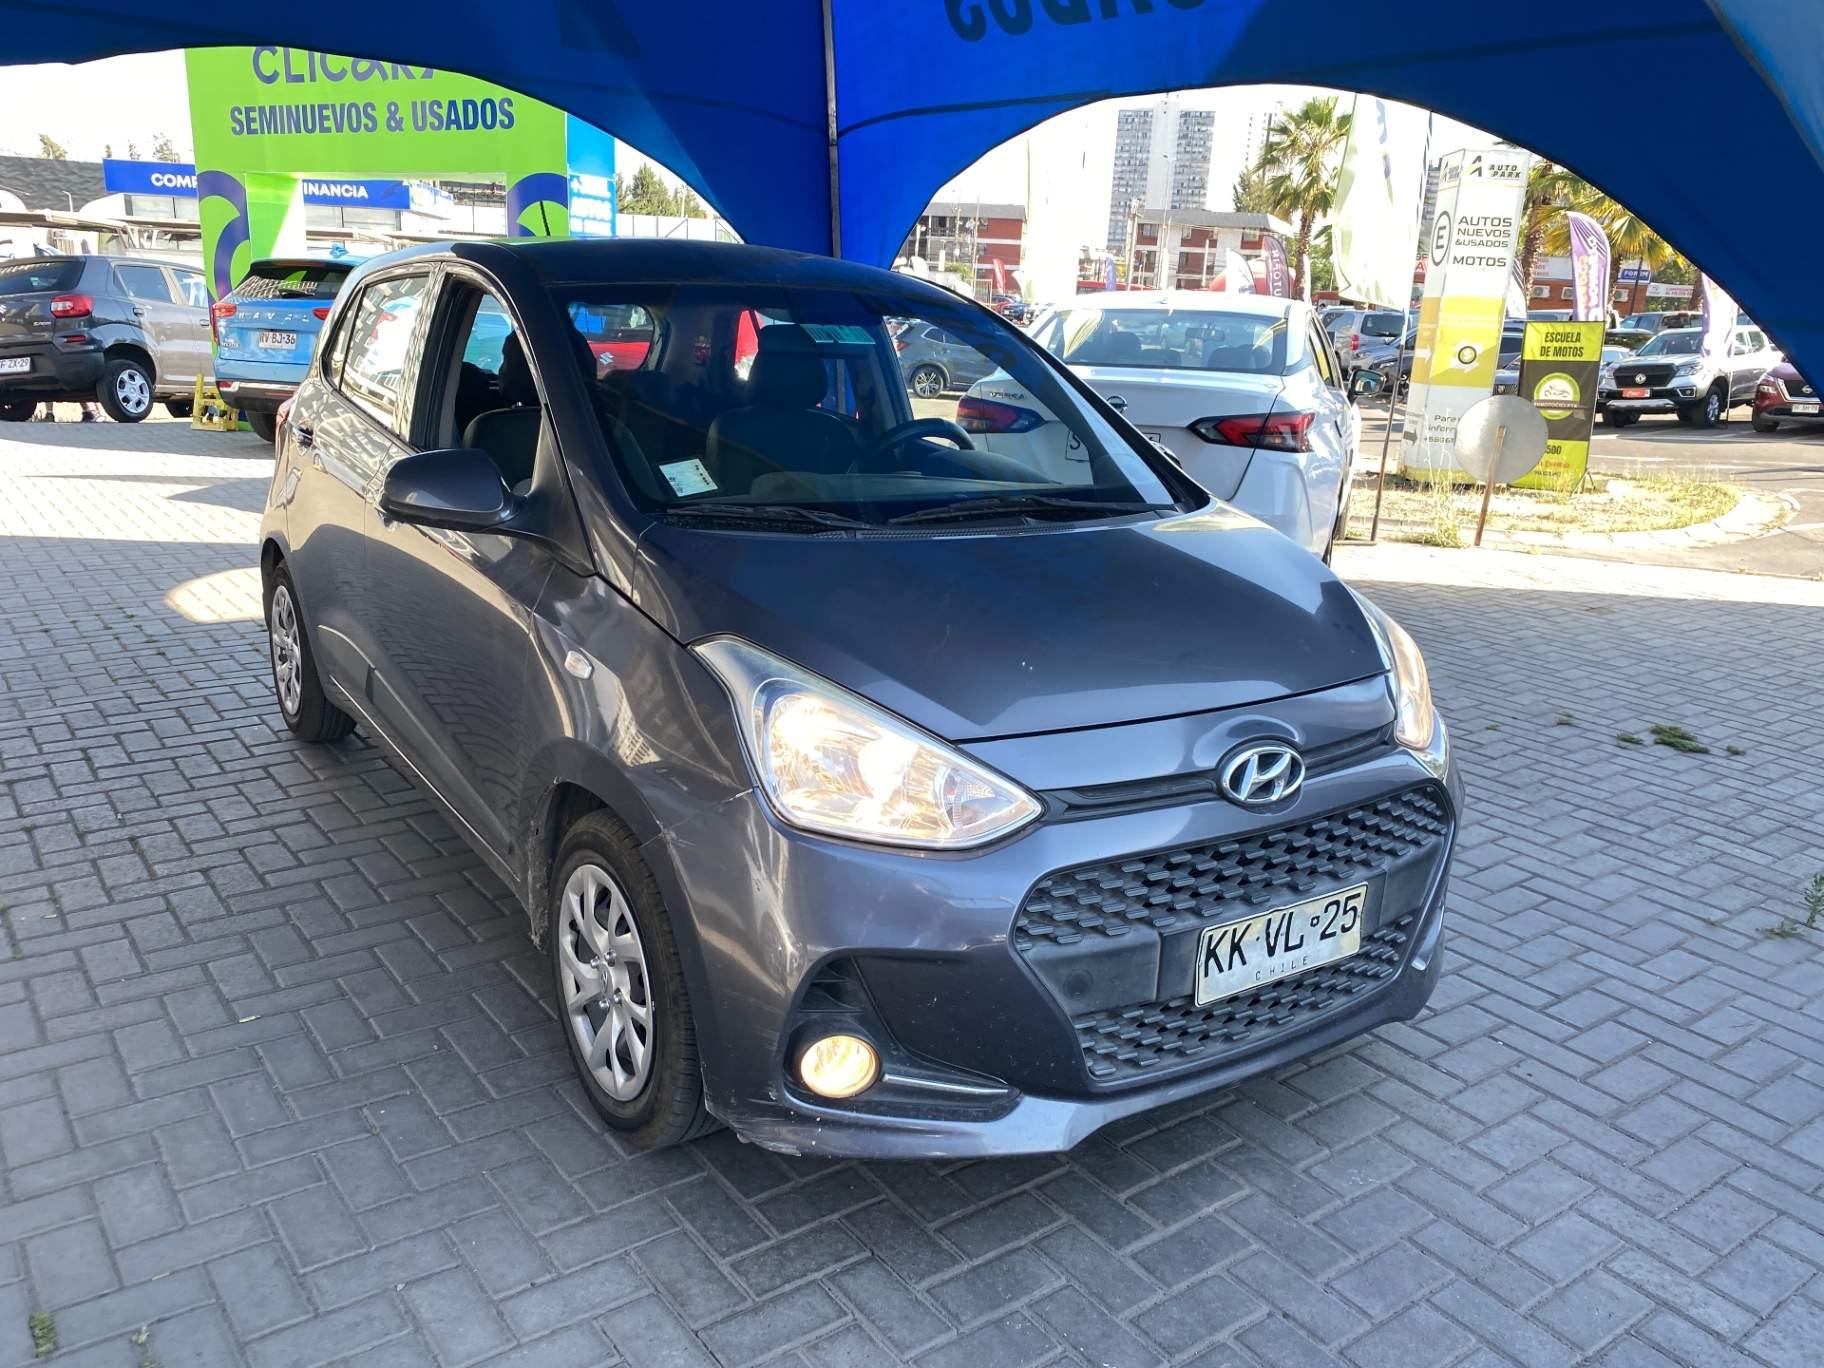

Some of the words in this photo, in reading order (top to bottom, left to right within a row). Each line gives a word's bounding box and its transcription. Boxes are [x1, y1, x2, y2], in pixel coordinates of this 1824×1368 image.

[229, 101, 378, 136] SEMINUEVOS
[385, 100, 405, 133] &
[411, 97, 515, 132] USADOS
[1458, 215, 1513, 228] AUTOS
[1456, 227, 1511, 238] NUEVOS
[1454, 238, 1509, 248] &USADOS
[1452, 255, 1507, 267] MOTOS
[1544, 331, 1582, 344] ESCUELA
[1539, 346, 1551, 357] DE
[1552, 346, 1584, 358] MOTOS
[1255, 957, 1309, 981] CHILE
